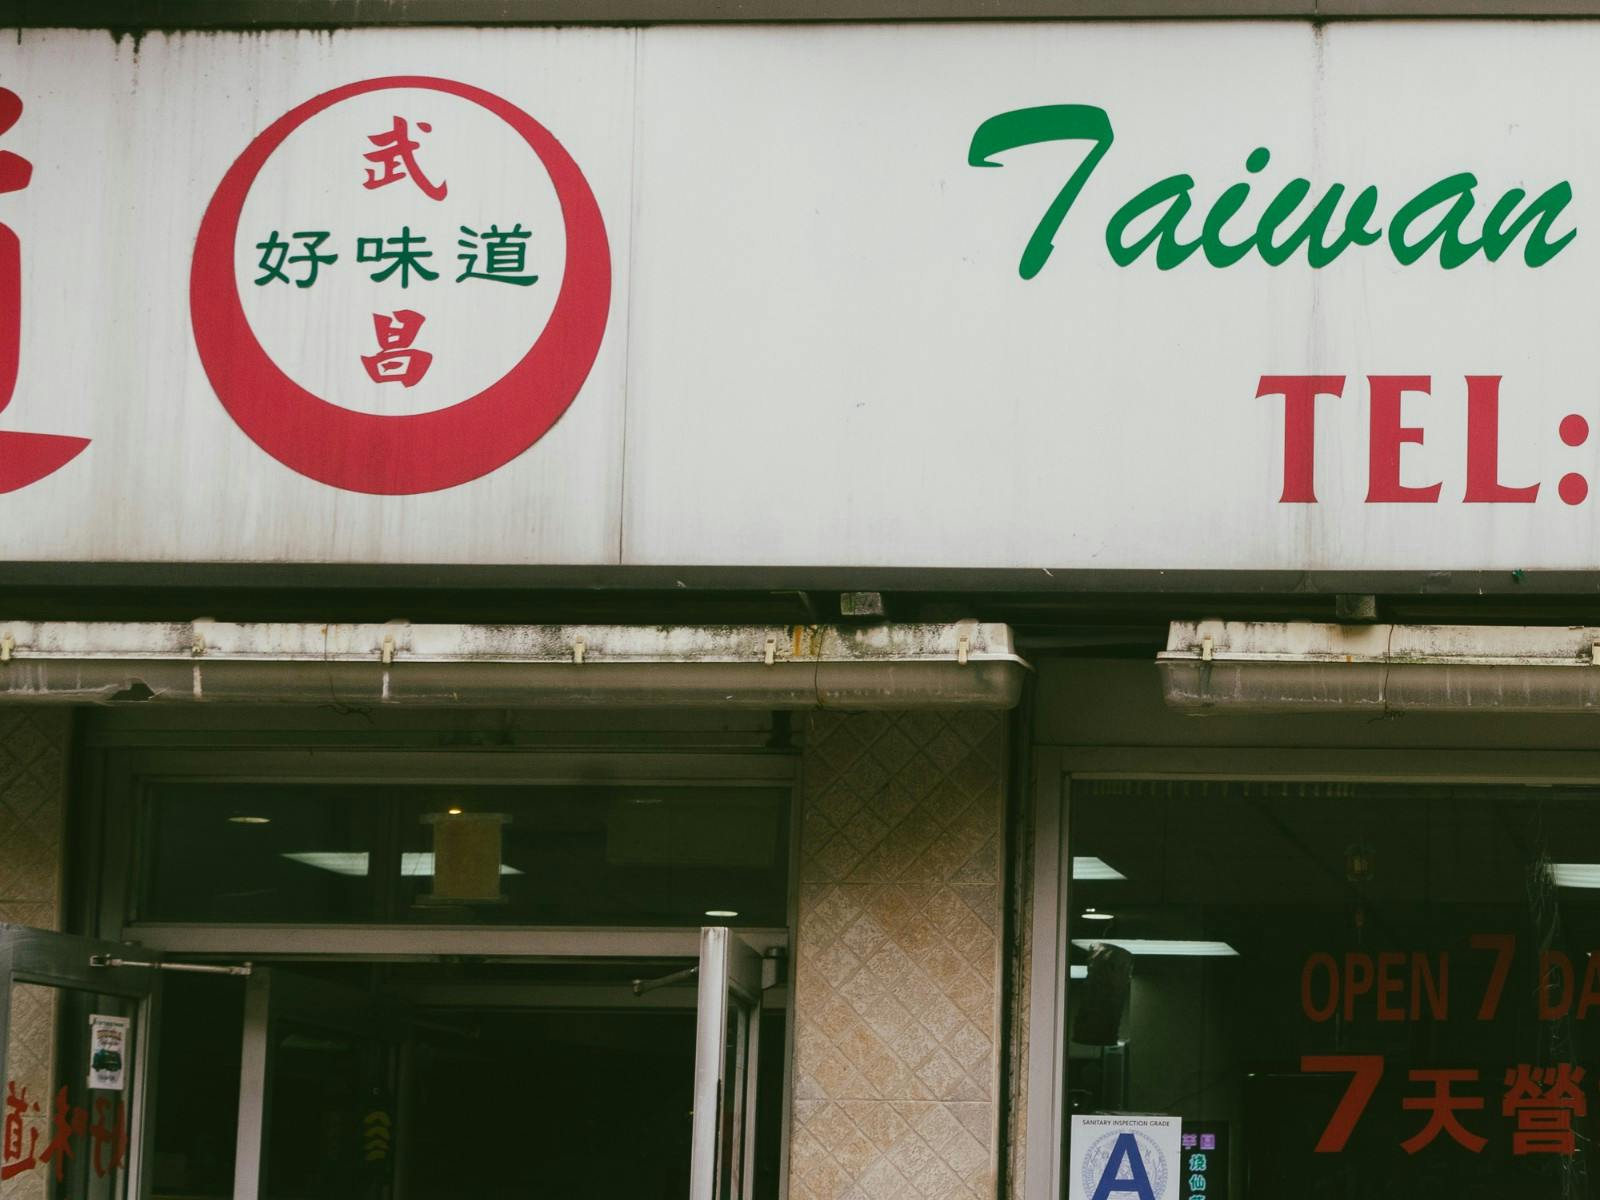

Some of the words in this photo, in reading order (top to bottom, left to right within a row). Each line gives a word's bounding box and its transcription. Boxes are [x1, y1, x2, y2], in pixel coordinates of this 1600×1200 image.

[365, 116, 447, 201] 武
[967, 103, 1577, 280] Taiwan
[255, 224, 539, 289] 好味道
[361, 309, 433, 388] 昌
[1301, 953, 1449, 1022] OPEN
[1468, 934, 1517, 1021] 7
[1091, 1132, 1158, 1200] A
